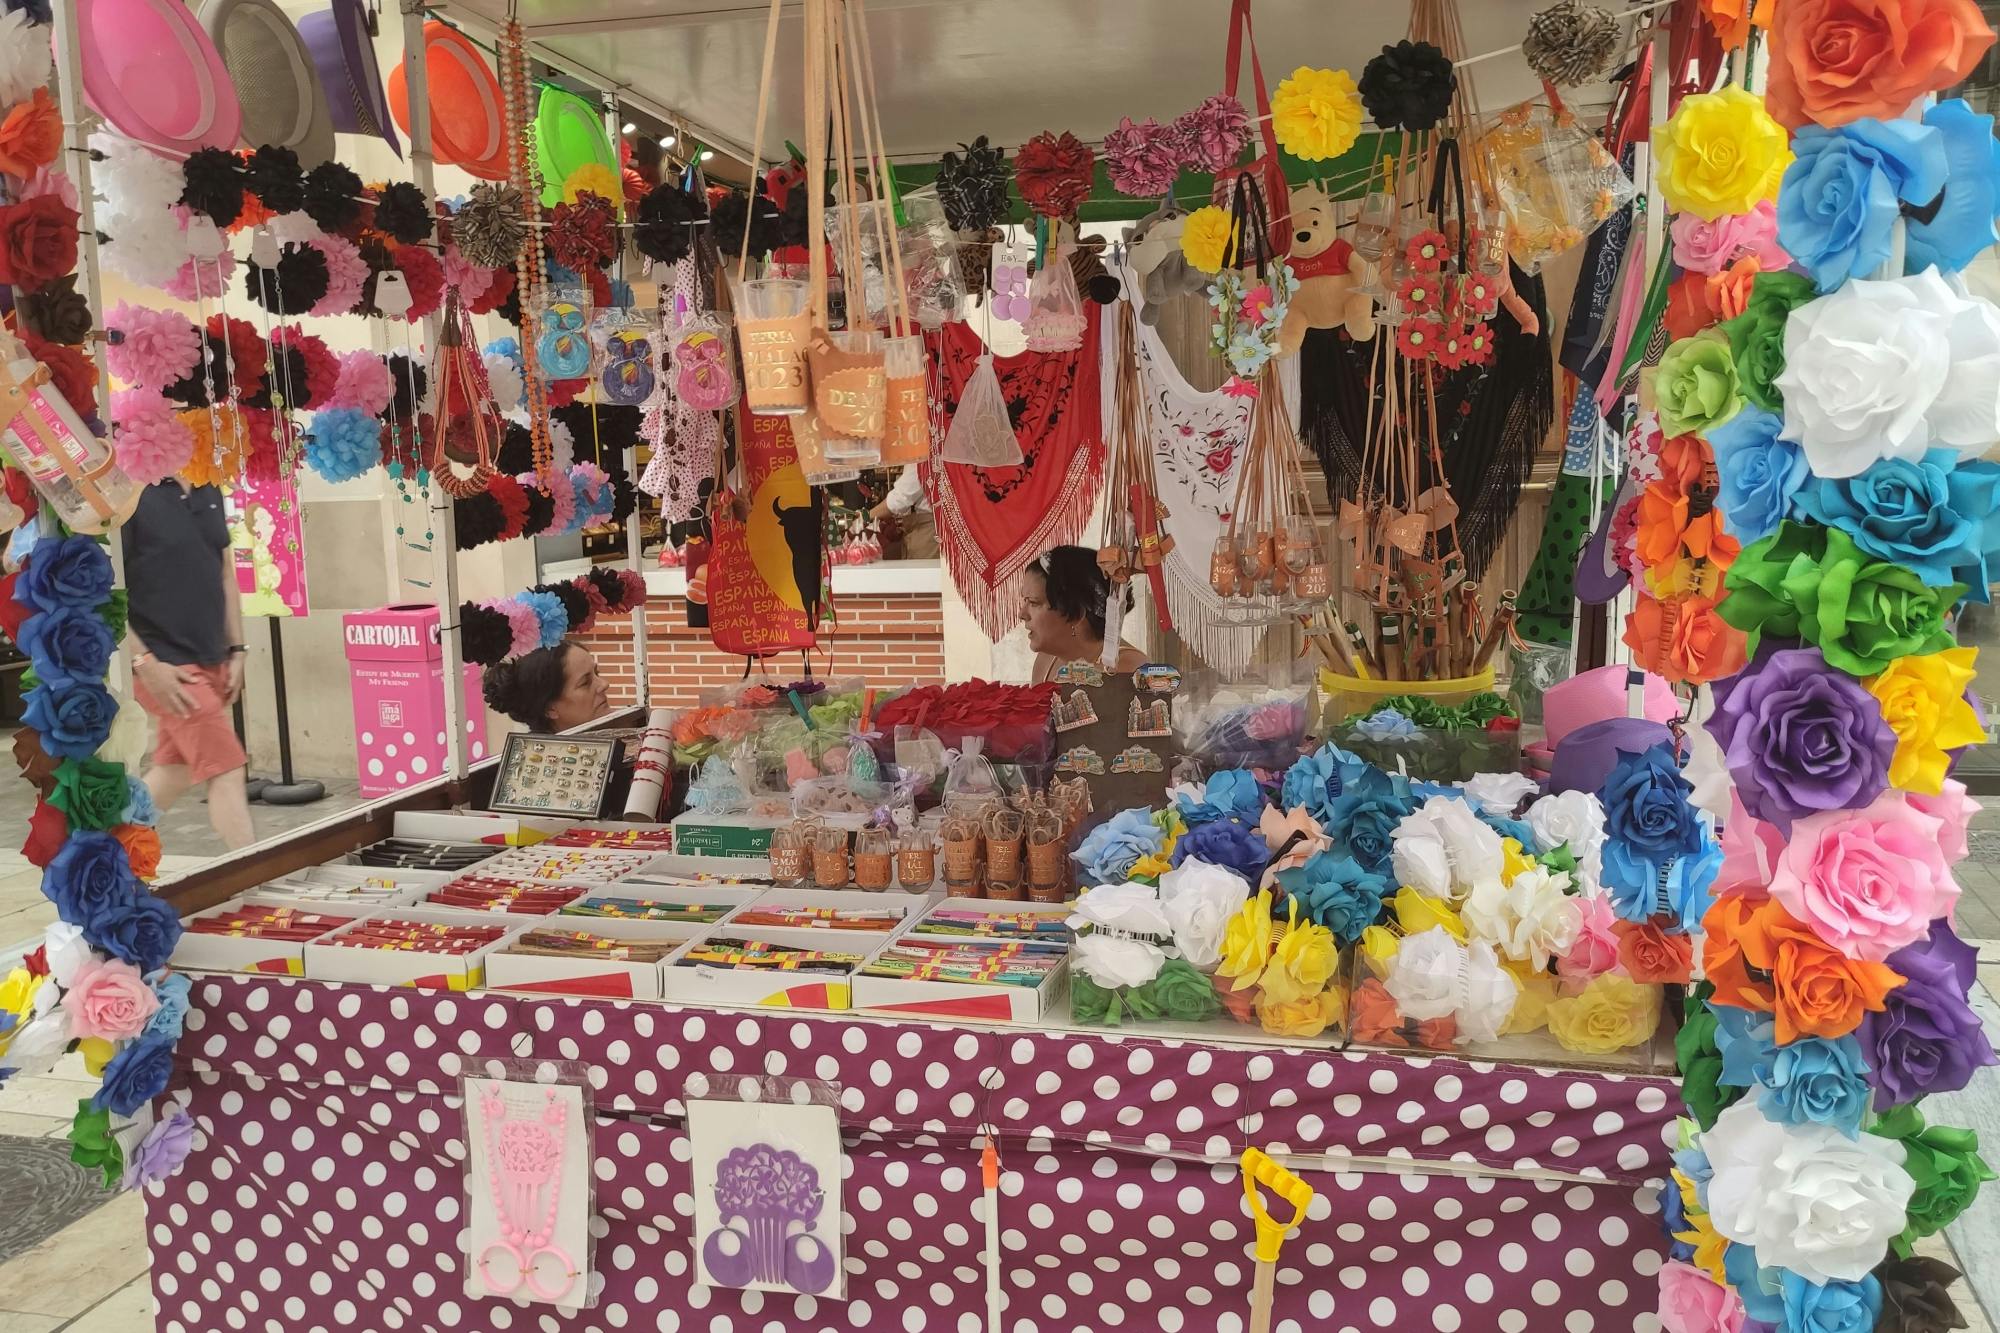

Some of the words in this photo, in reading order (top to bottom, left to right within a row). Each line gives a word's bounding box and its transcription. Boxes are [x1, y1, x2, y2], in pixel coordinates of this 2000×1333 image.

[751, 330, 796, 345] FERIA
[744, 440, 771, 450] SPAÑA
[728, 570, 761, 585] ESPA
[714, 602, 746, 617] ESPAÑA
[712, 614, 757, 632] ESPAÑA
[346, 624, 420, 648] CARTOJAL
[742, 624, 790, 645] ESPAÑA
